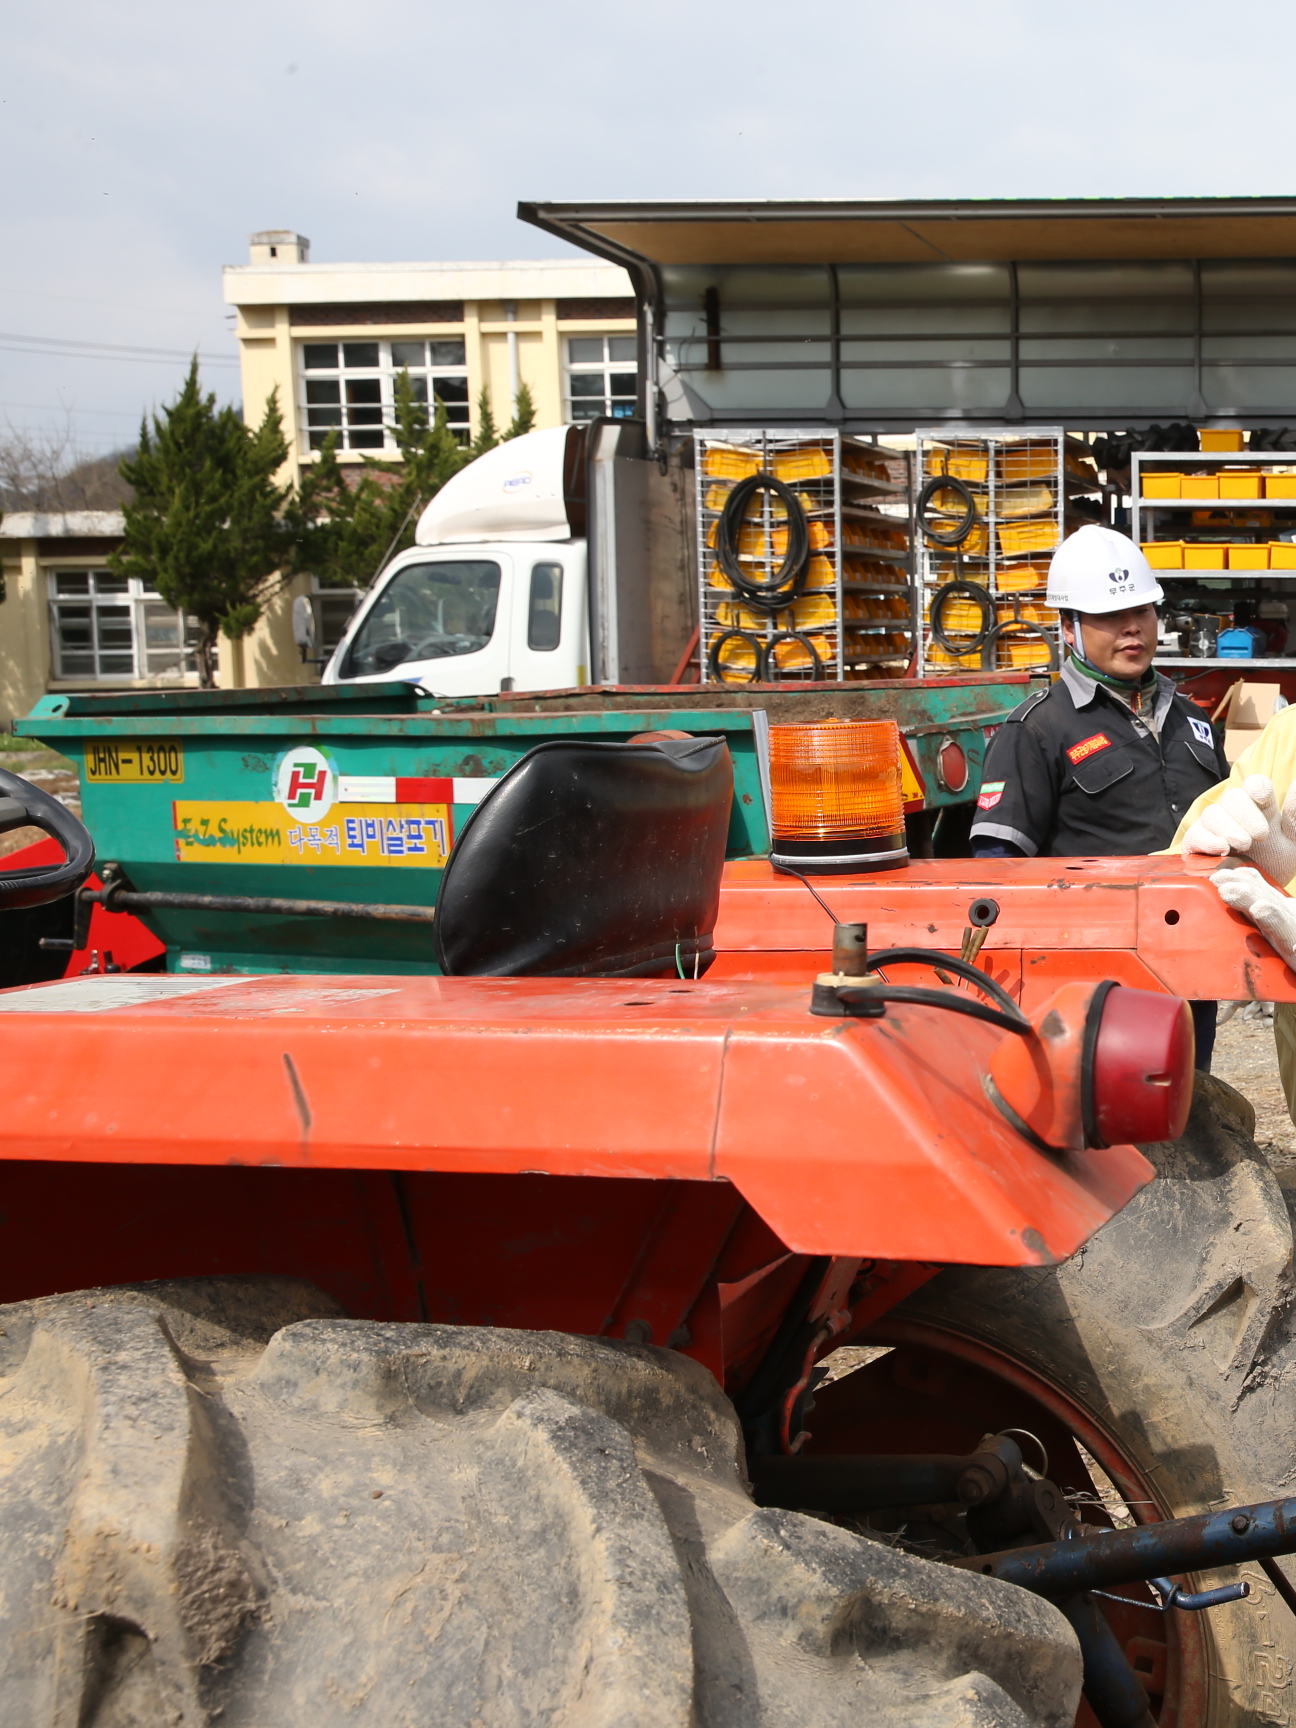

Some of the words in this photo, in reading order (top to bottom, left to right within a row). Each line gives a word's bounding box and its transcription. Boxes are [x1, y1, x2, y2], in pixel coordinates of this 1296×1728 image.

[1109, 583, 1136, 596] 무주군
[90, 745, 179, 776] JHN-1300
[217, 817, 282, 855] System
[288, 825, 341, 855] 다목적
[344, 817, 447, 856] 퇴비살포기
